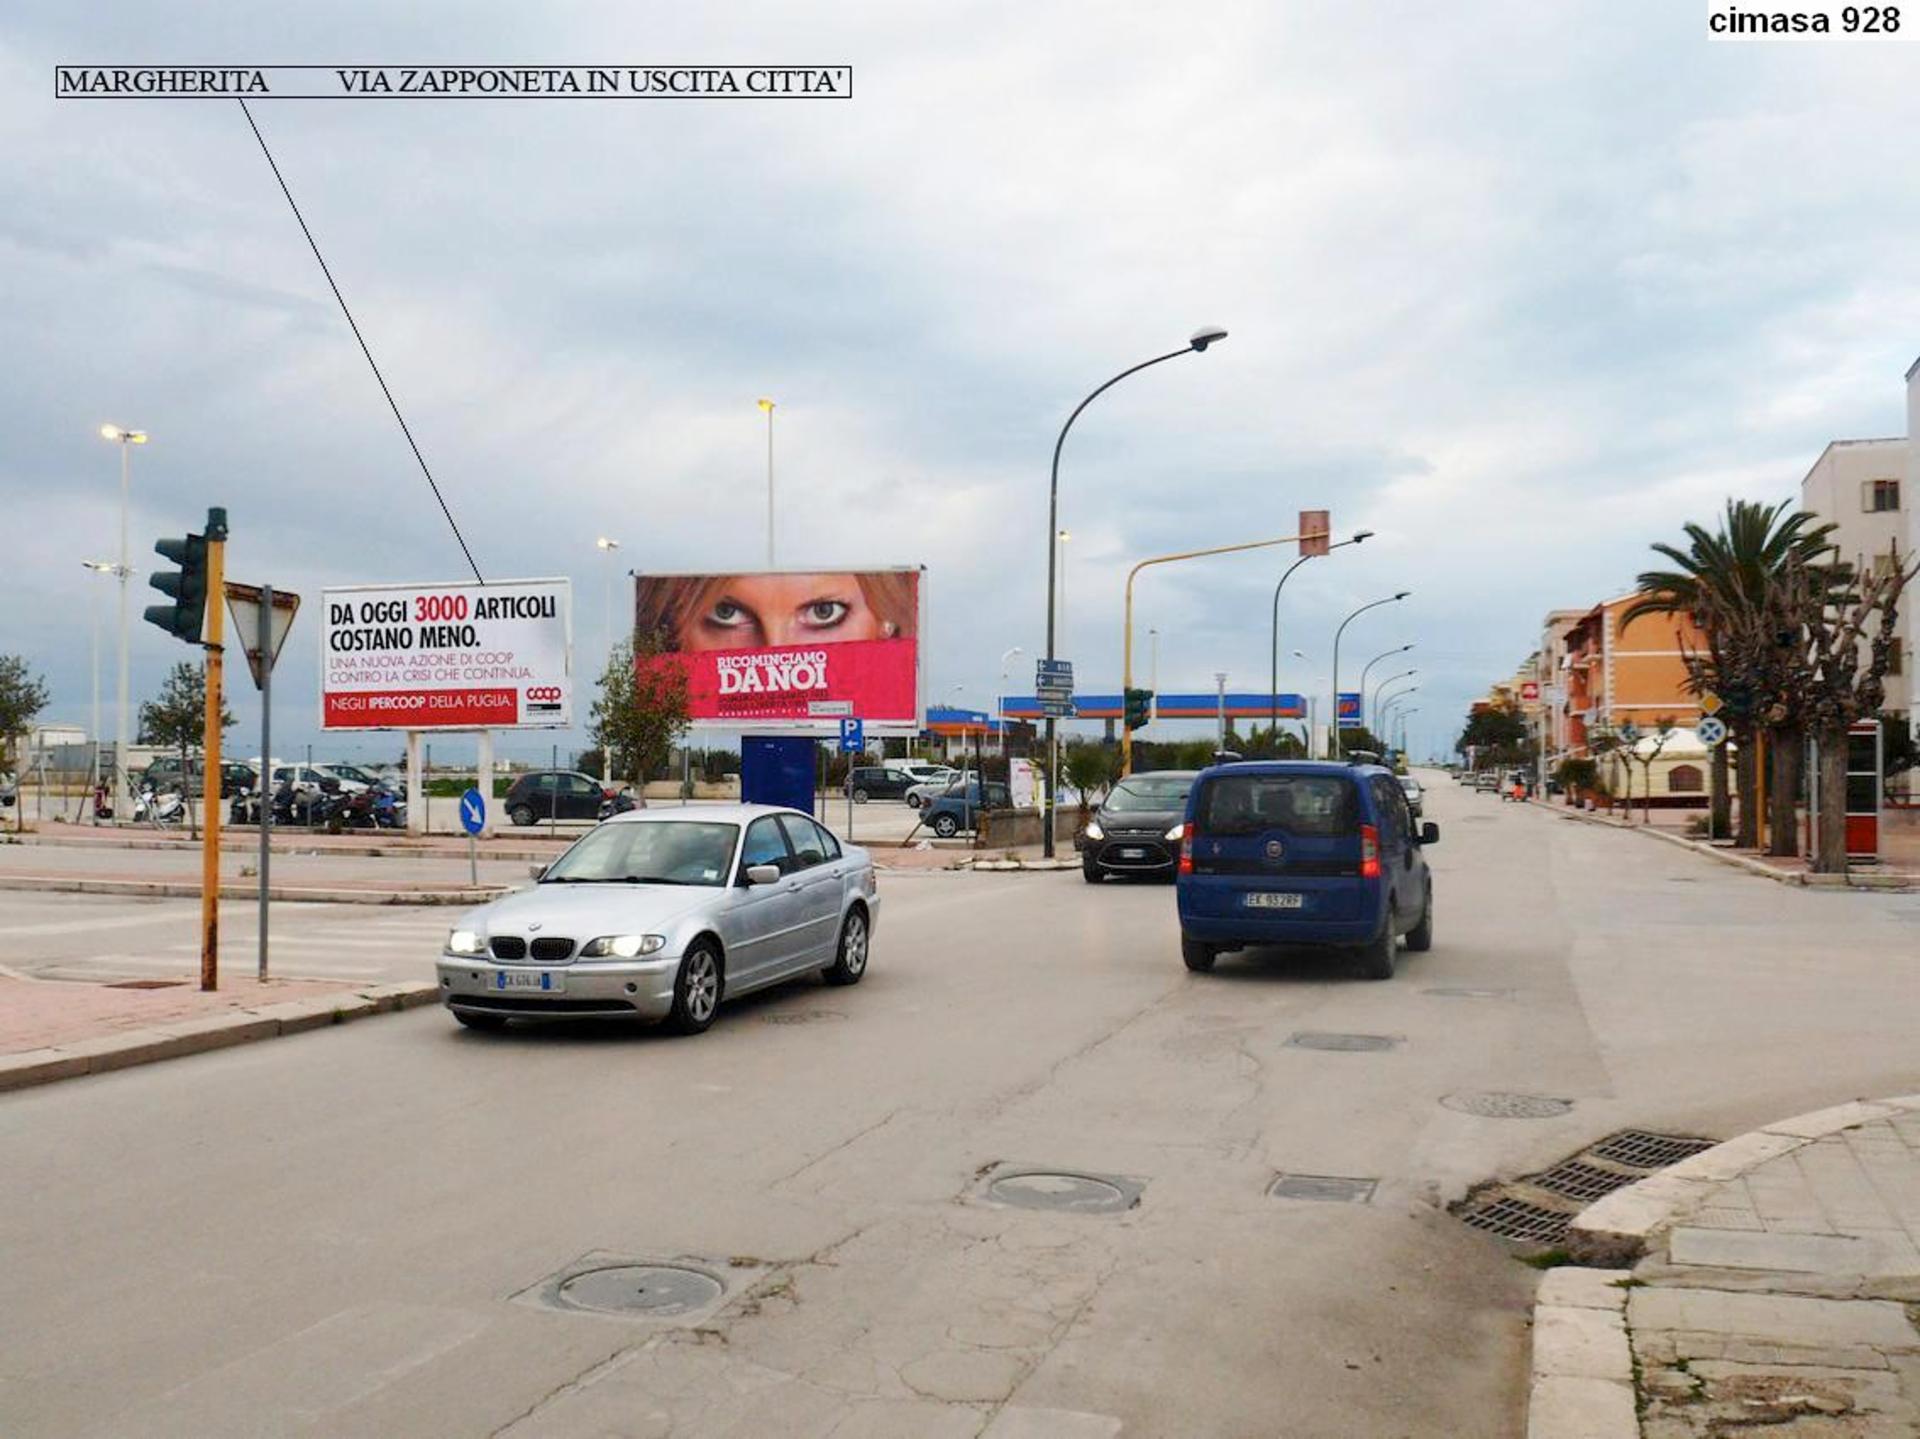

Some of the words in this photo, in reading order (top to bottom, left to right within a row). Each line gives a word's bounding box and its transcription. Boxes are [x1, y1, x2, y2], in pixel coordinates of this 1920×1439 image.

[331, 603, 355, 625] DA
[360, 600, 407, 624] OGGI
[415, 595, 468, 622] 3000
[474, 595, 556, 620] ARTICOLI
[330, 627, 413, 652] COSTANO
[419, 625, 481, 648] MENO.
[330, 656, 358, 669] UNA
[361, 656, 405, 668] NUOVA
[409, 653, 456, 666] AZIONE
[460, 653, 472, 666] DI
[475, 651, 514, 665] COOP
[716, 651, 828, 669] RICOMINCIAMO
[330, 670, 382, 684] CONTRO
[385, 670, 399, 682] LA
[402, 669, 431, 682] CRISI
[434, 668, 460, 681] CHE
[463, 666, 535, 680] CONTINUA.
[718, 666, 764, 695] DA
[765, 663, 828, 692] NOI
[331, 697, 367, 711] NEGLI
[369, 695, 426, 709] IPERCOOP
[429, 695, 465, 708] DELLA
[467, 694, 514, 708] PUGLIA.
[526, 687, 561, 703] coop
[845, 720, 858, 736] P
